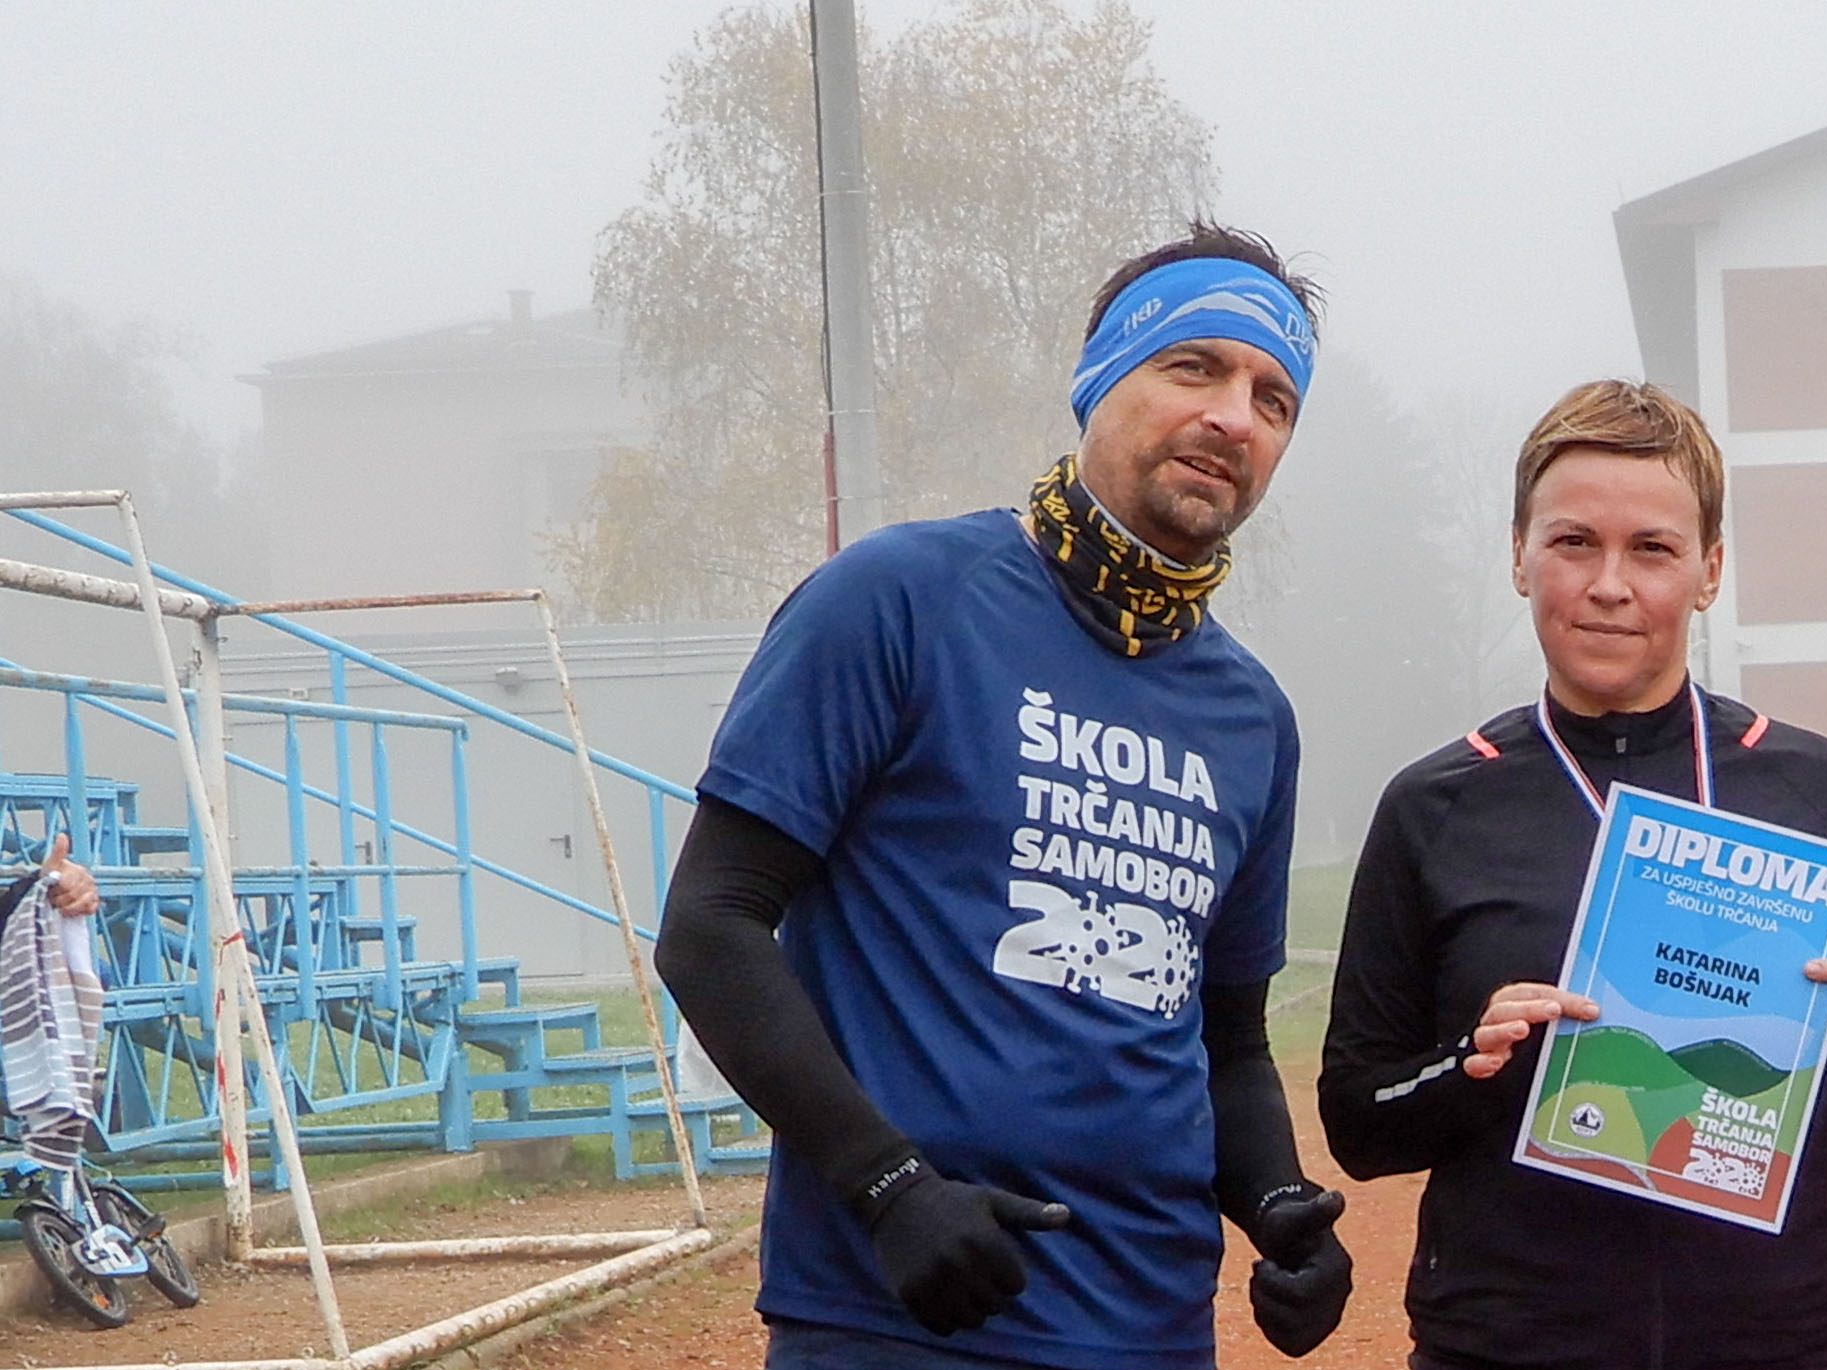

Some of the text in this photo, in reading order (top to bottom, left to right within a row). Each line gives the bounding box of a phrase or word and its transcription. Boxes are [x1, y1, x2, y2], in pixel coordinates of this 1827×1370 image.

[1018, 687, 1219, 813] ŠKOLA
[1018, 775, 1216, 870] TRČANJA
[1010, 828, 1217, 918] SAMOBOR
[1641, 866, 1814, 924] ZA USPJEŠNO ZAVRŠENU
[1666, 890, 1779, 933] ŠKOLU TRČANJA
[1655, 942, 1761, 985] KATARINA
[1654, 967, 1753, 1008] BOŠNJAK
[1700, 1086, 1777, 1130] ŠKOLA
[1691, 1131, 1771, 1164] SAMOBOR
[1697, 1115, 1774, 1149] TRČANJA
